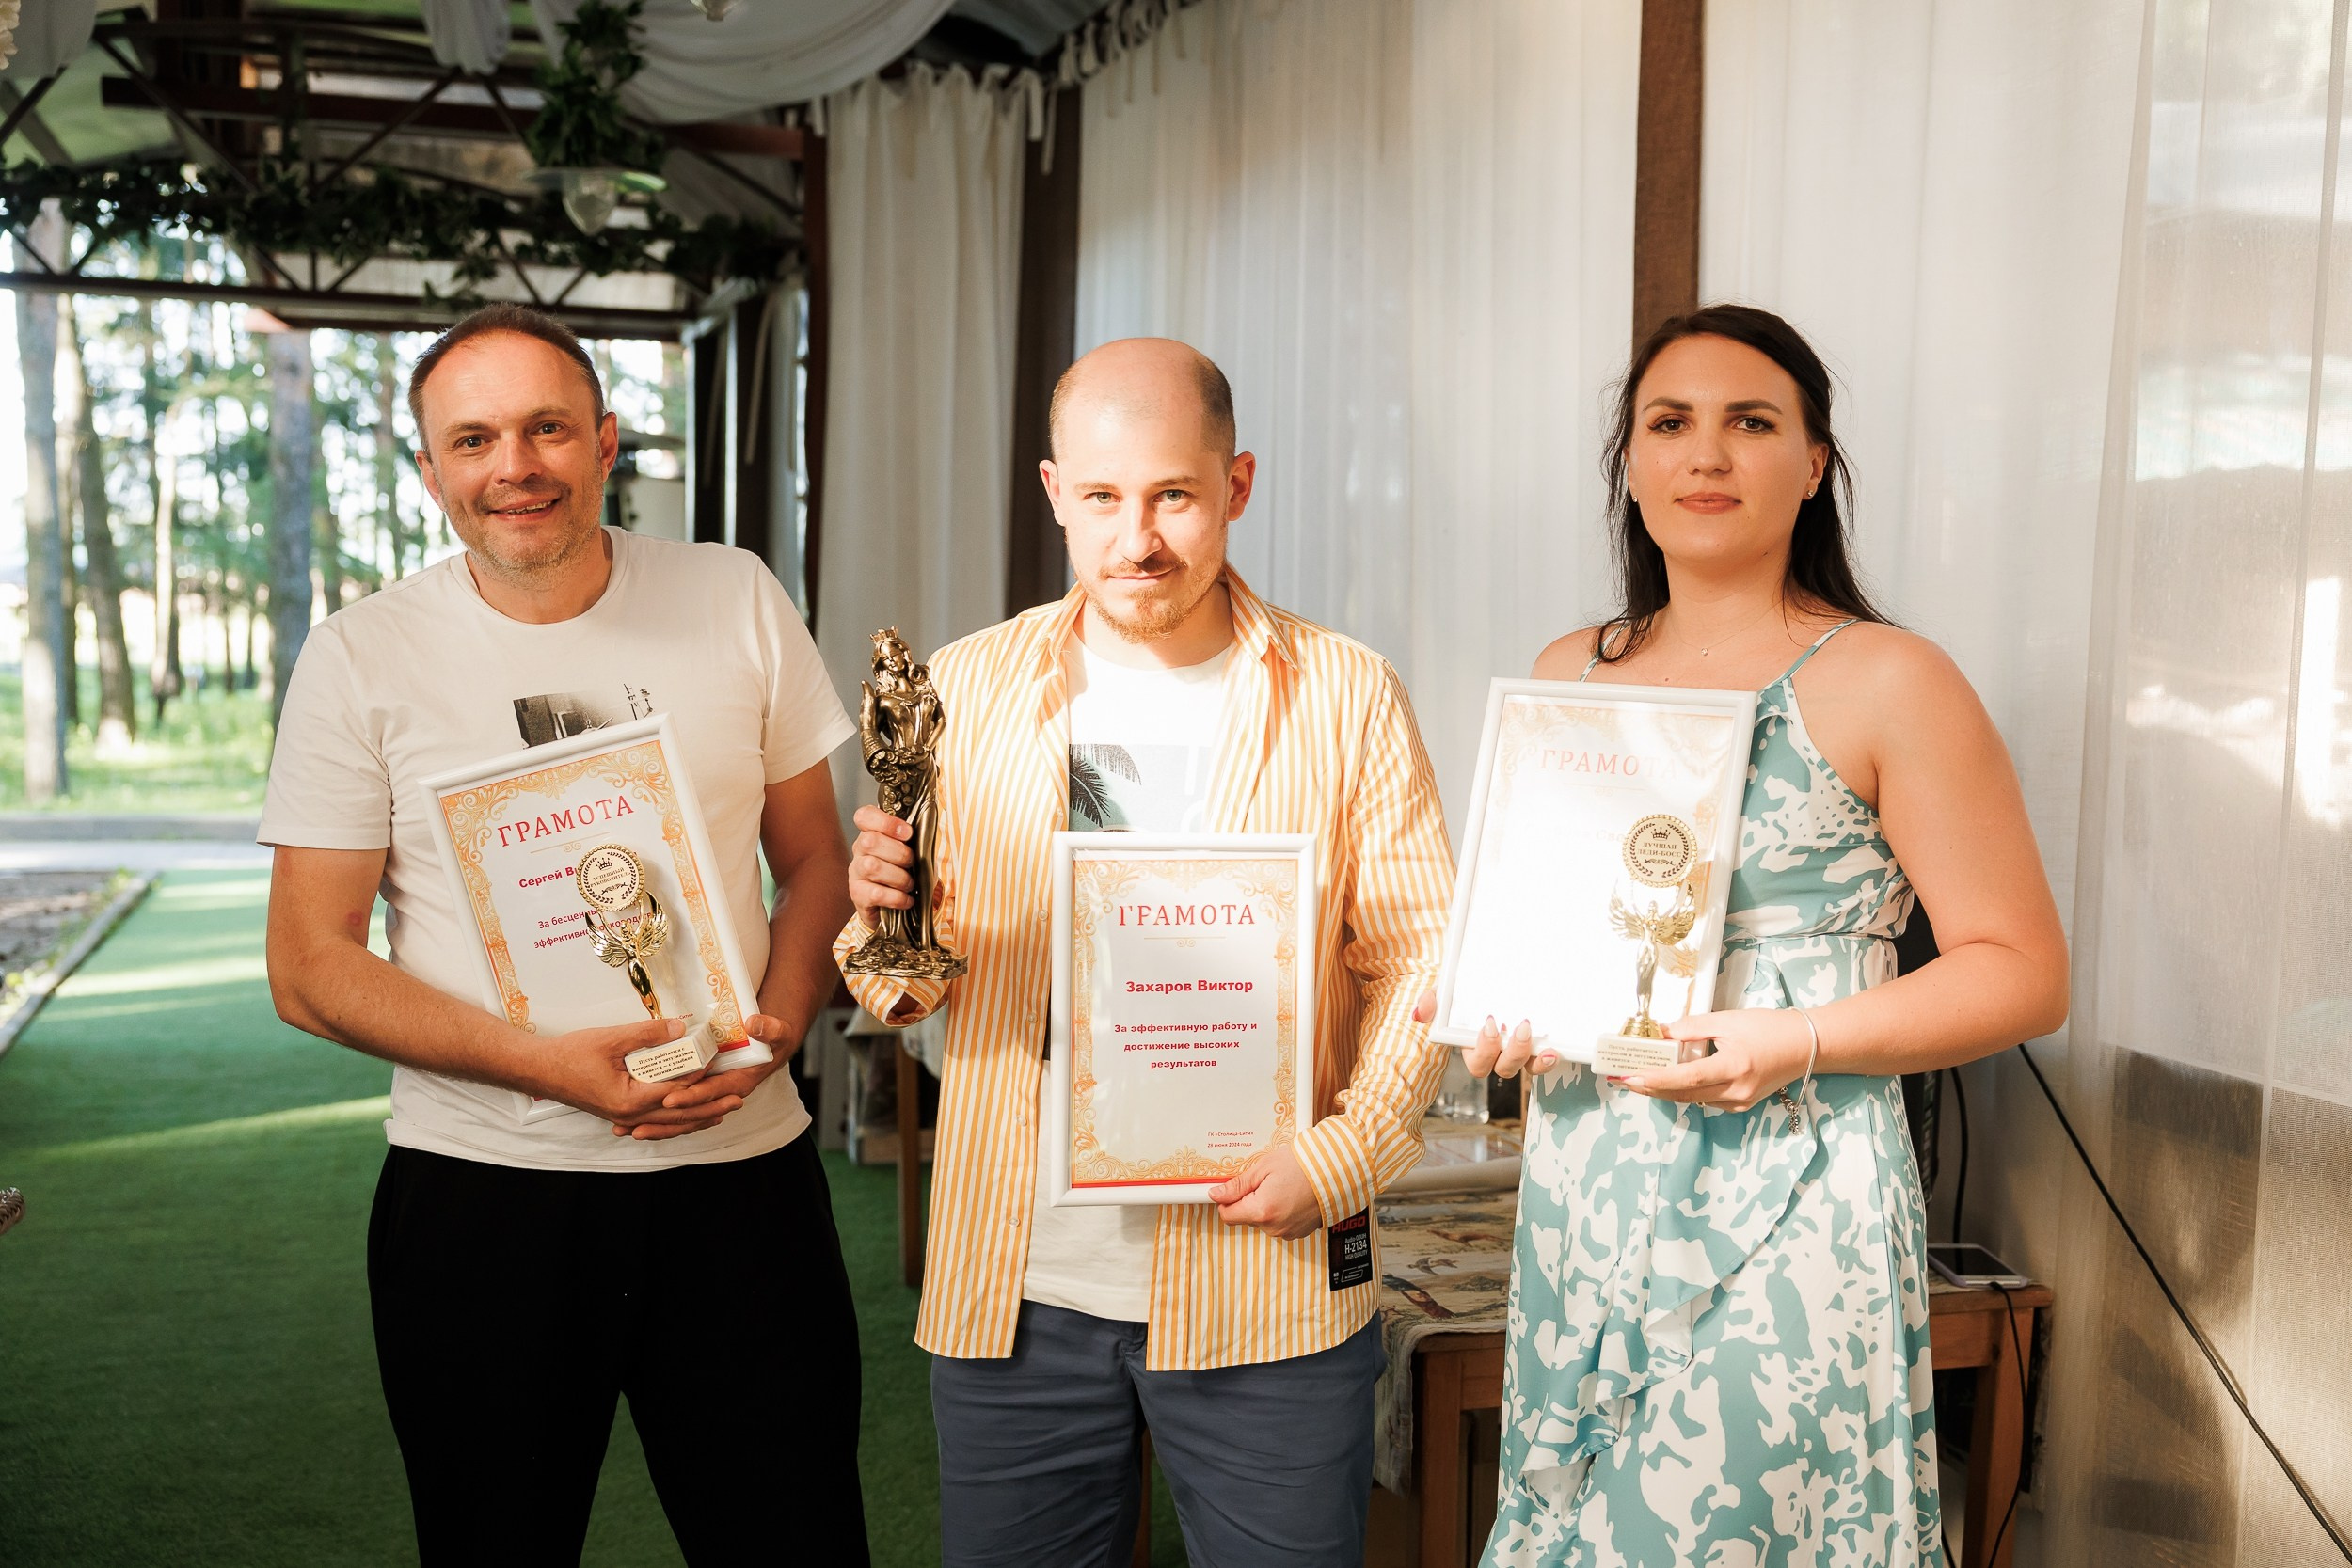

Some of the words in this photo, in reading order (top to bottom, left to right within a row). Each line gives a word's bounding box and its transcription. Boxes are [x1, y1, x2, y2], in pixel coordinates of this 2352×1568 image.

[498, 795, 635, 847] ГРАМОТА
[518, 869, 563, 889] Сергей
[1119, 904, 1256, 927] ГРАМОТА
[537, 920, 550, 929] За
[1125, 980, 1192, 997] Захаров
[1197, 979, 1254, 996] Виктор
[1114, 1023, 1127, 1033] За
[1130, 1022, 1209, 1035] эффективную
[1211, 1022, 1248, 1033] работу
[1250, 1022, 1258, 1031] и
[1123, 1041, 1191, 1053] достижение
[1193, 1040, 1240, 1050] высоких
[1151, 1059, 1217, 1070] результатов
[1332, 1215, 1366, 1234] HUGO
[1344, 1239, 1368, 1255] H-2134
